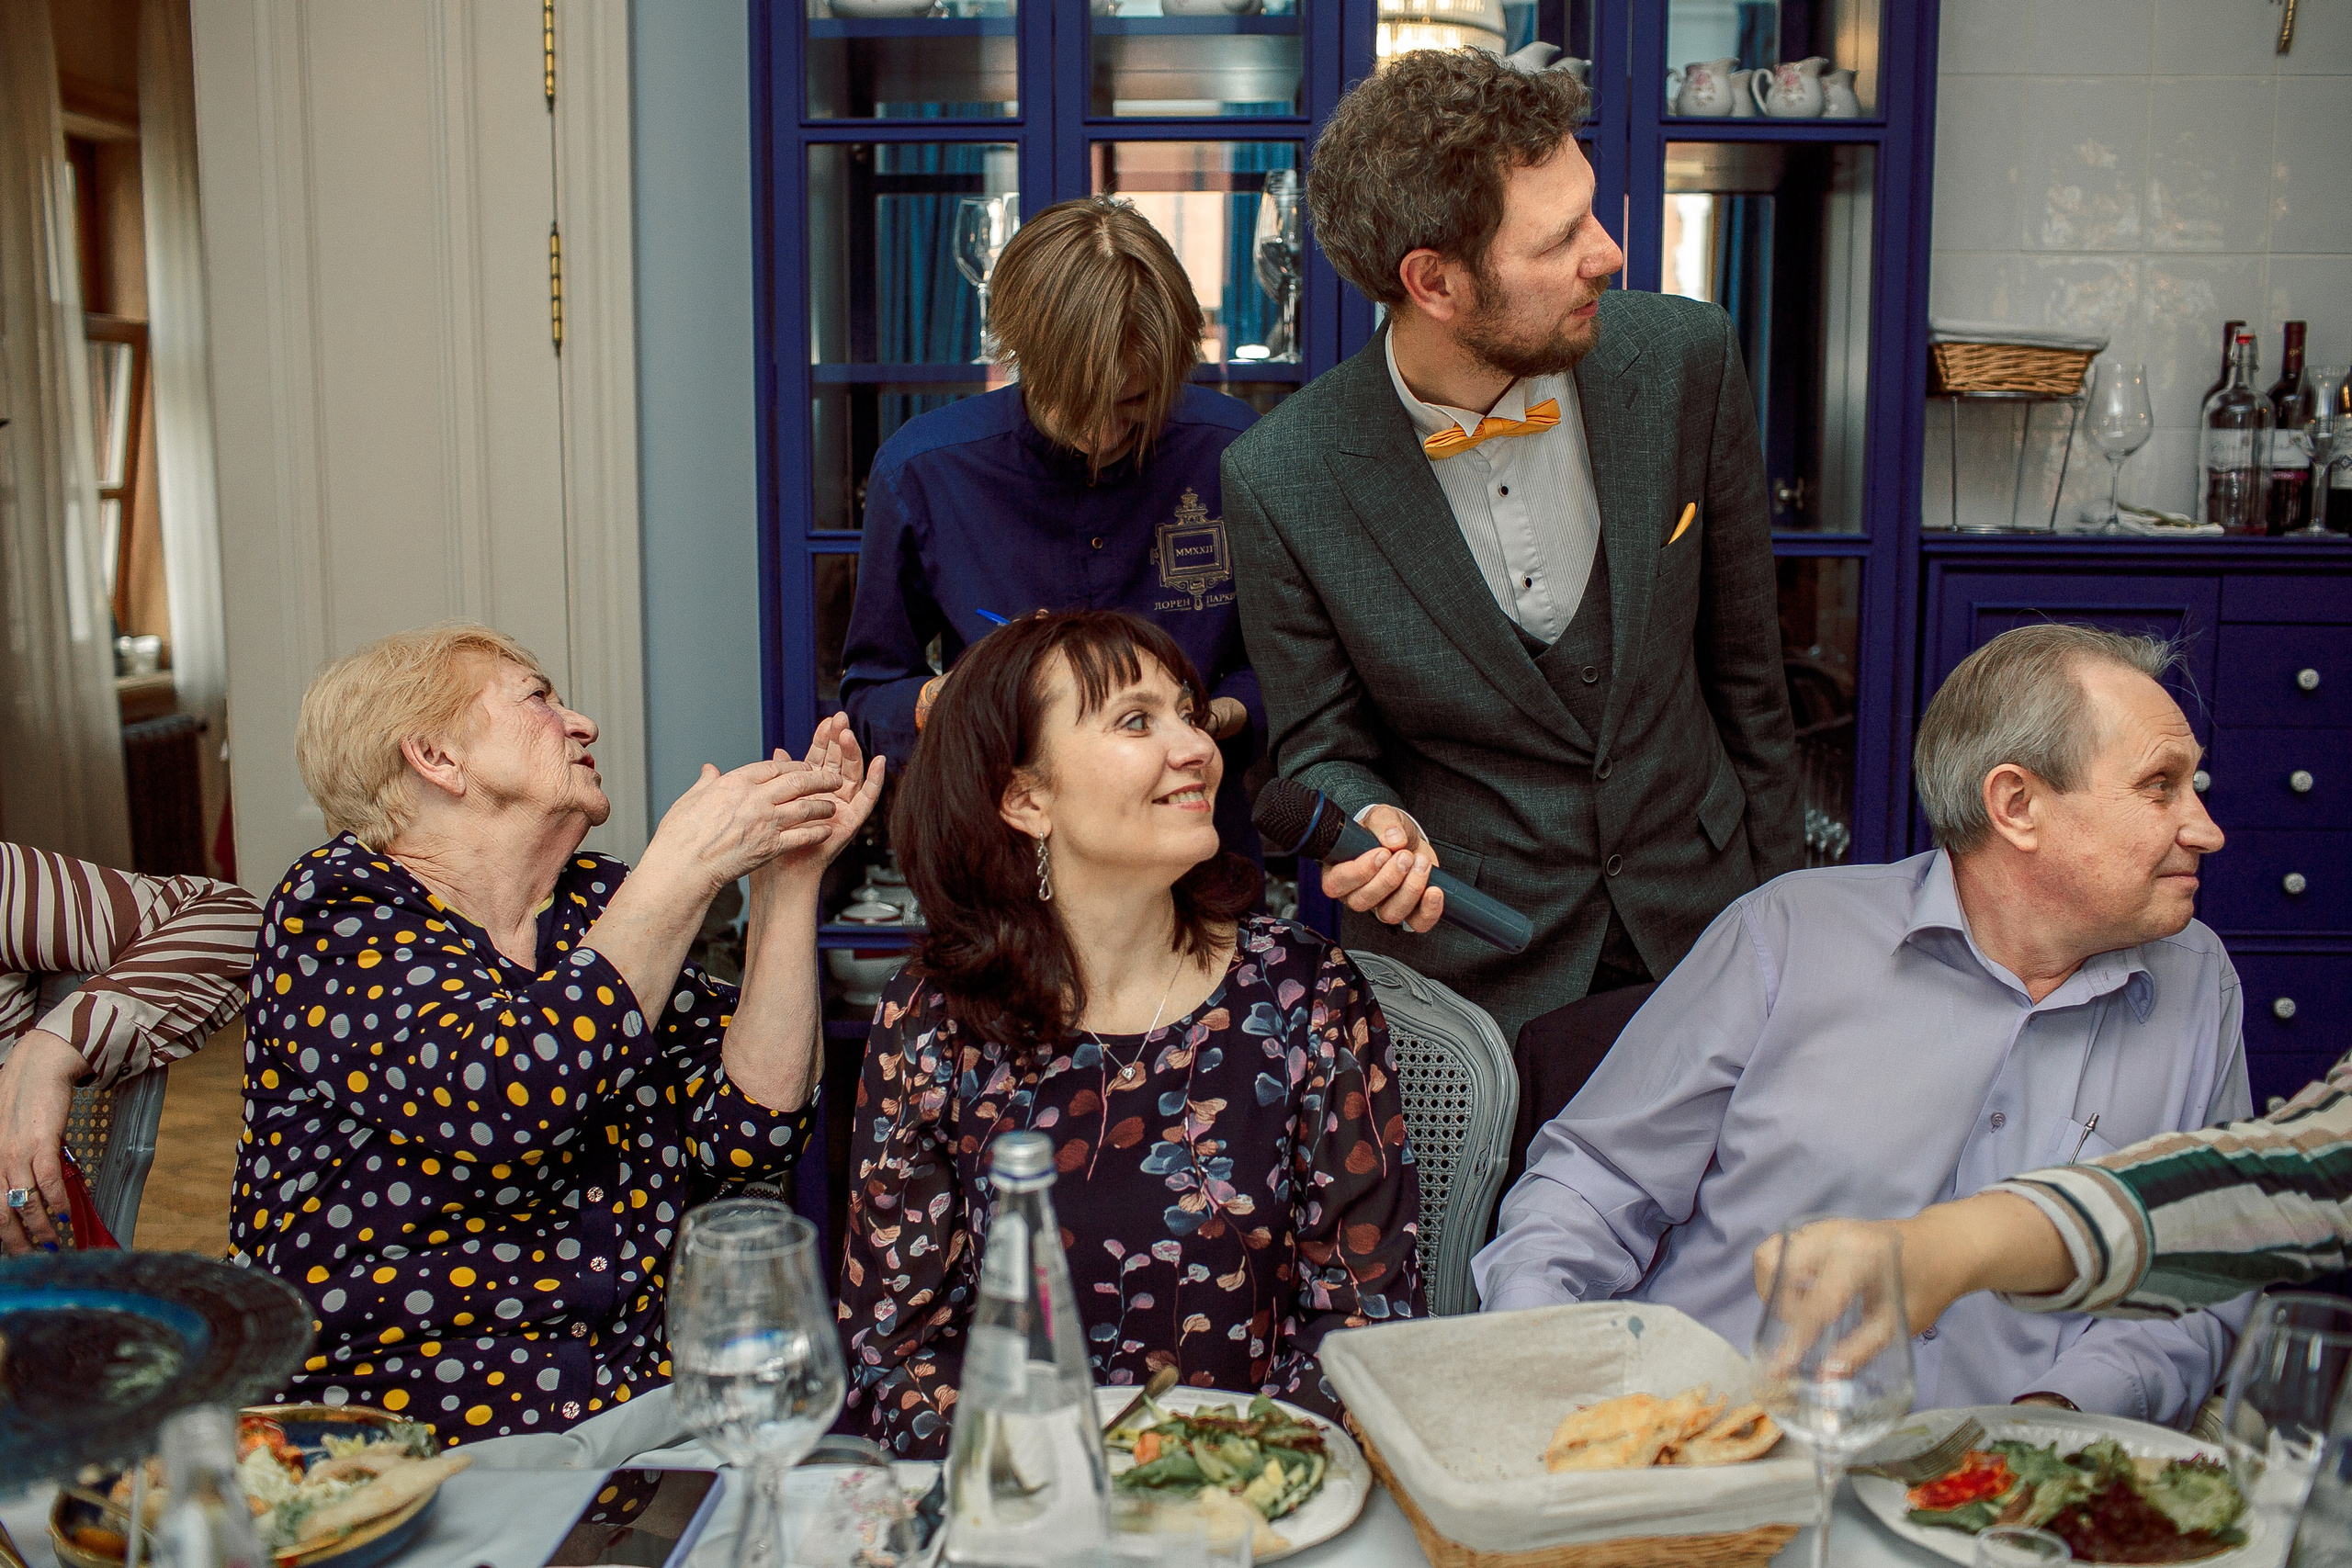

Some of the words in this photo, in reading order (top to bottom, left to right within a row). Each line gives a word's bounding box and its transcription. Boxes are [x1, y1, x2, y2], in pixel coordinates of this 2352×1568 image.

[1175, 545, 1213, 557] MMXXII
[1154, 598, 1191, 611] ЛОРЕН
[1206, 592, 1238, 604] ПАРКЕ
